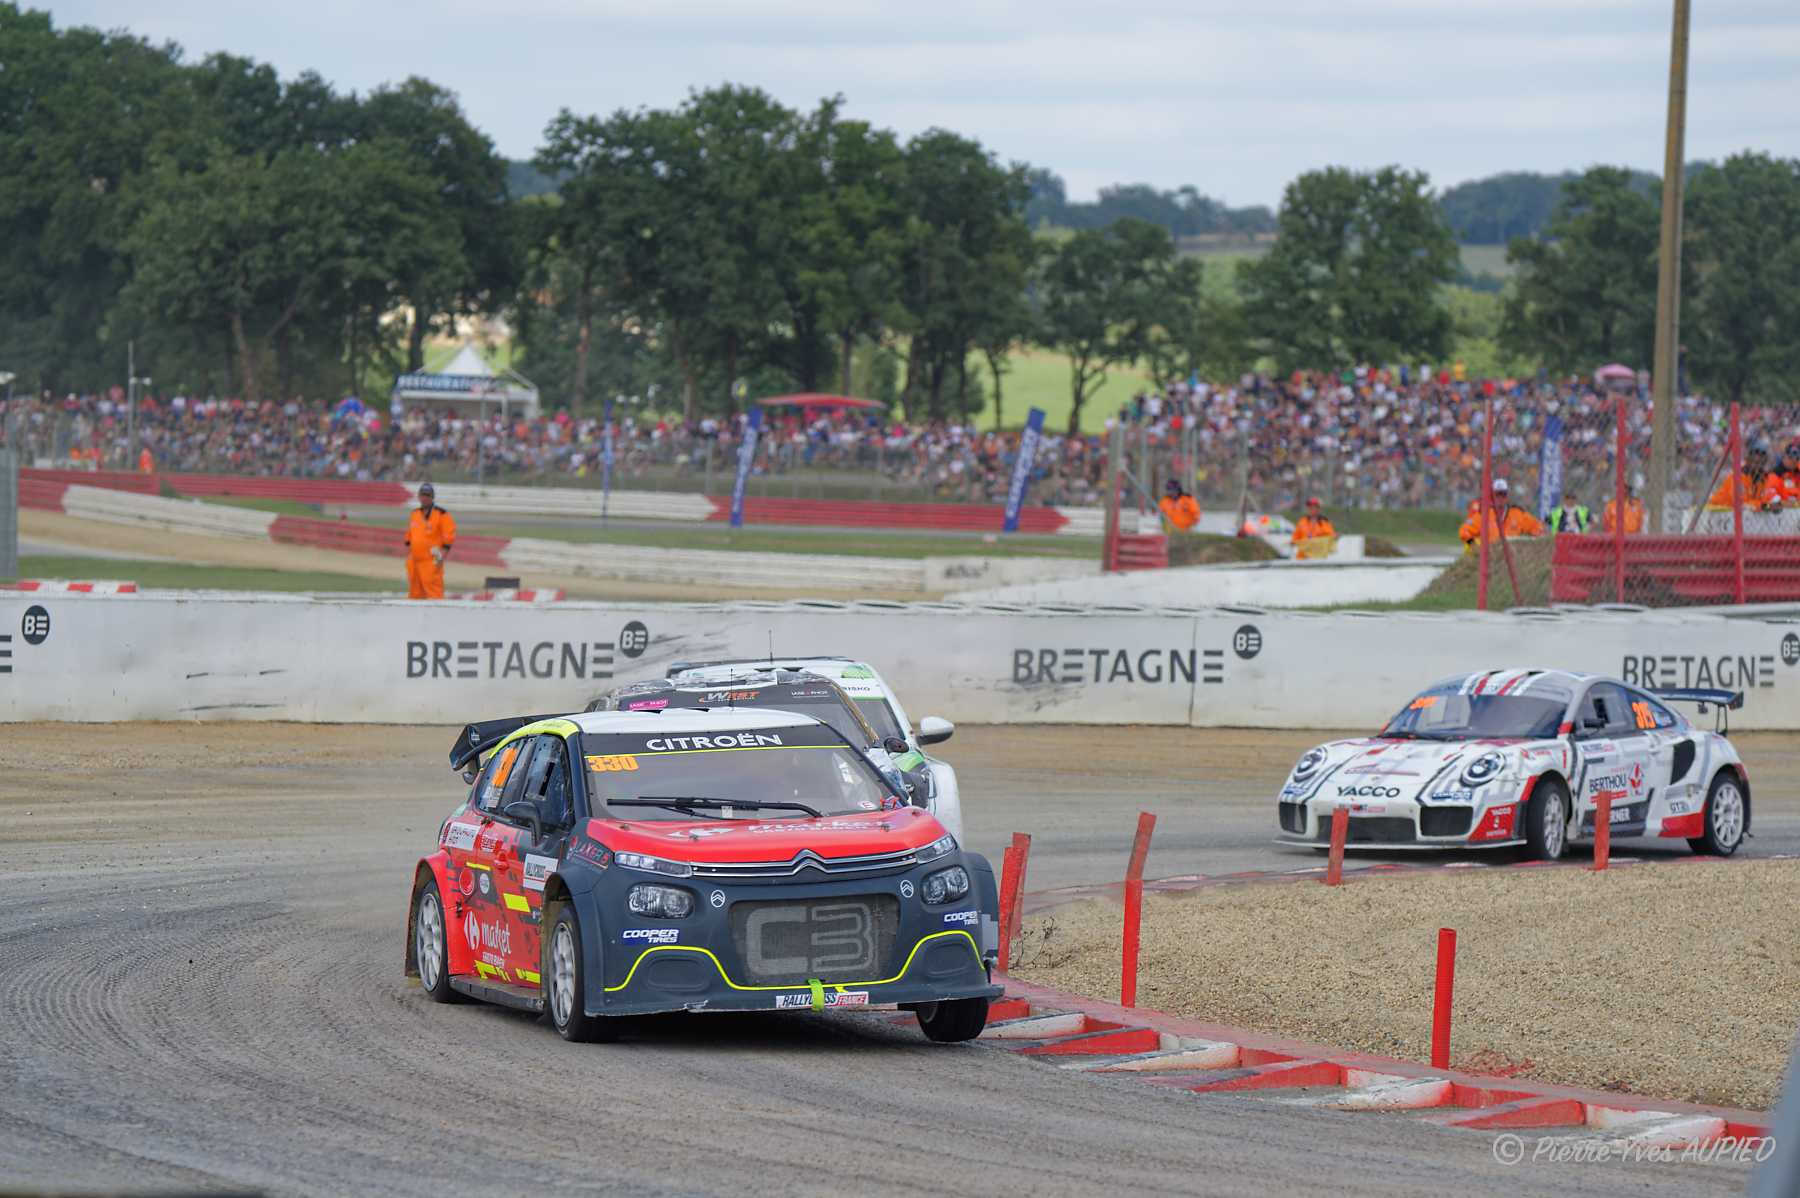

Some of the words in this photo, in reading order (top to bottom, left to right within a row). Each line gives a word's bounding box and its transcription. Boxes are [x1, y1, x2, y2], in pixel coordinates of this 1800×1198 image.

[406, 641, 615, 678] BRETAGNE
[1012, 649, 1224, 684] BRETAGNE
[1622, 655, 1775, 689] BRETAGNE
[646, 733, 783, 751] CITROËN
[587, 755, 639, 772] 330
[1337, 785, 1400, 798] YACCO
[1589, 774, 1627, 793] BERTHOU
[622, 929, 679, 939] COOPER
[648, 936, 678, 944] TIRES
[746, 903, 872, 977] C3
